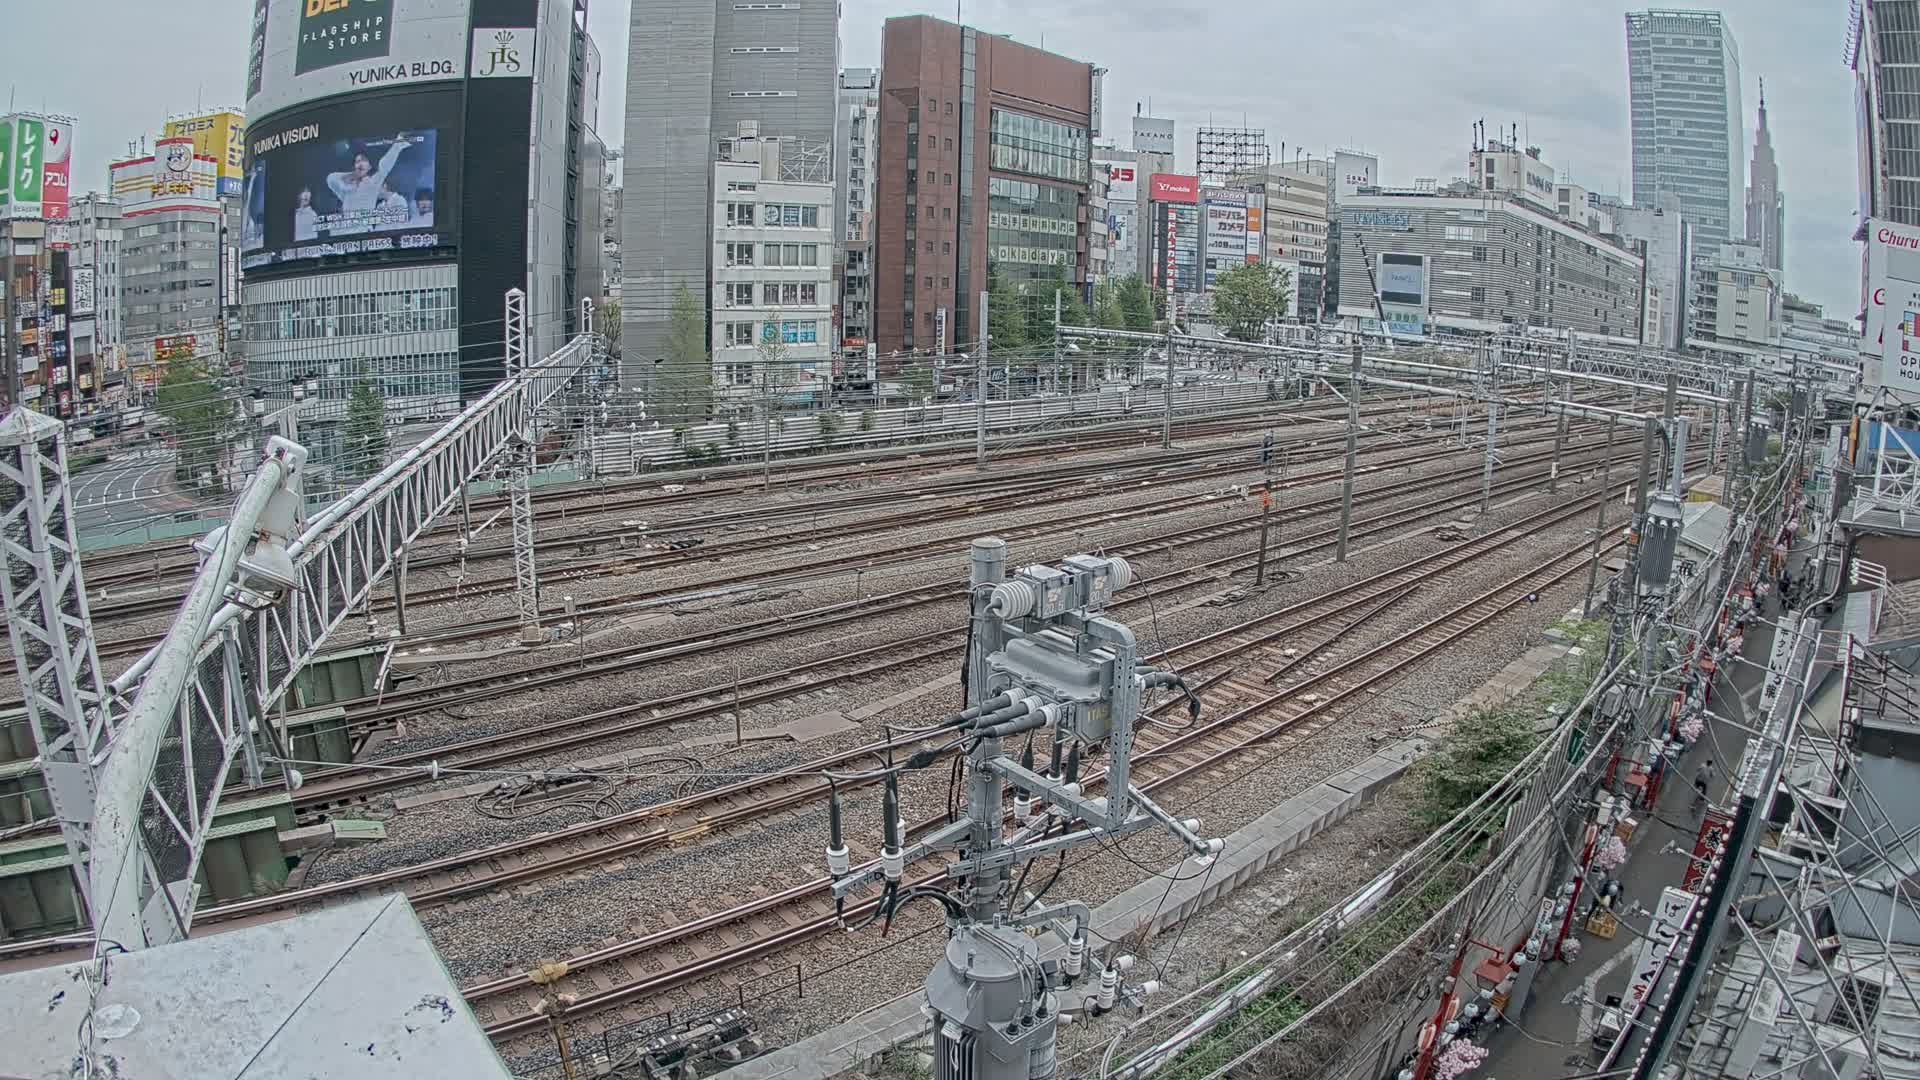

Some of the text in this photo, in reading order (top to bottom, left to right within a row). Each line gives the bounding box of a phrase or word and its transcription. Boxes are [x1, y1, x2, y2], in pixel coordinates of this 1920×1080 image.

[303, 16, 383, 44] FLAGSHIP
[328, 30, 382, 50] STORE
[349, 60, 456, 85] YUNIKA BLDG.
[175, 119, 215, 136] プロミス
[1134, 131, 1173, 140] TAKANO
[254, 123, 319, 156] YUNIKA VISION
[20, 123, 36, 190] レイク
[45, 171, 67, 187] アコム
